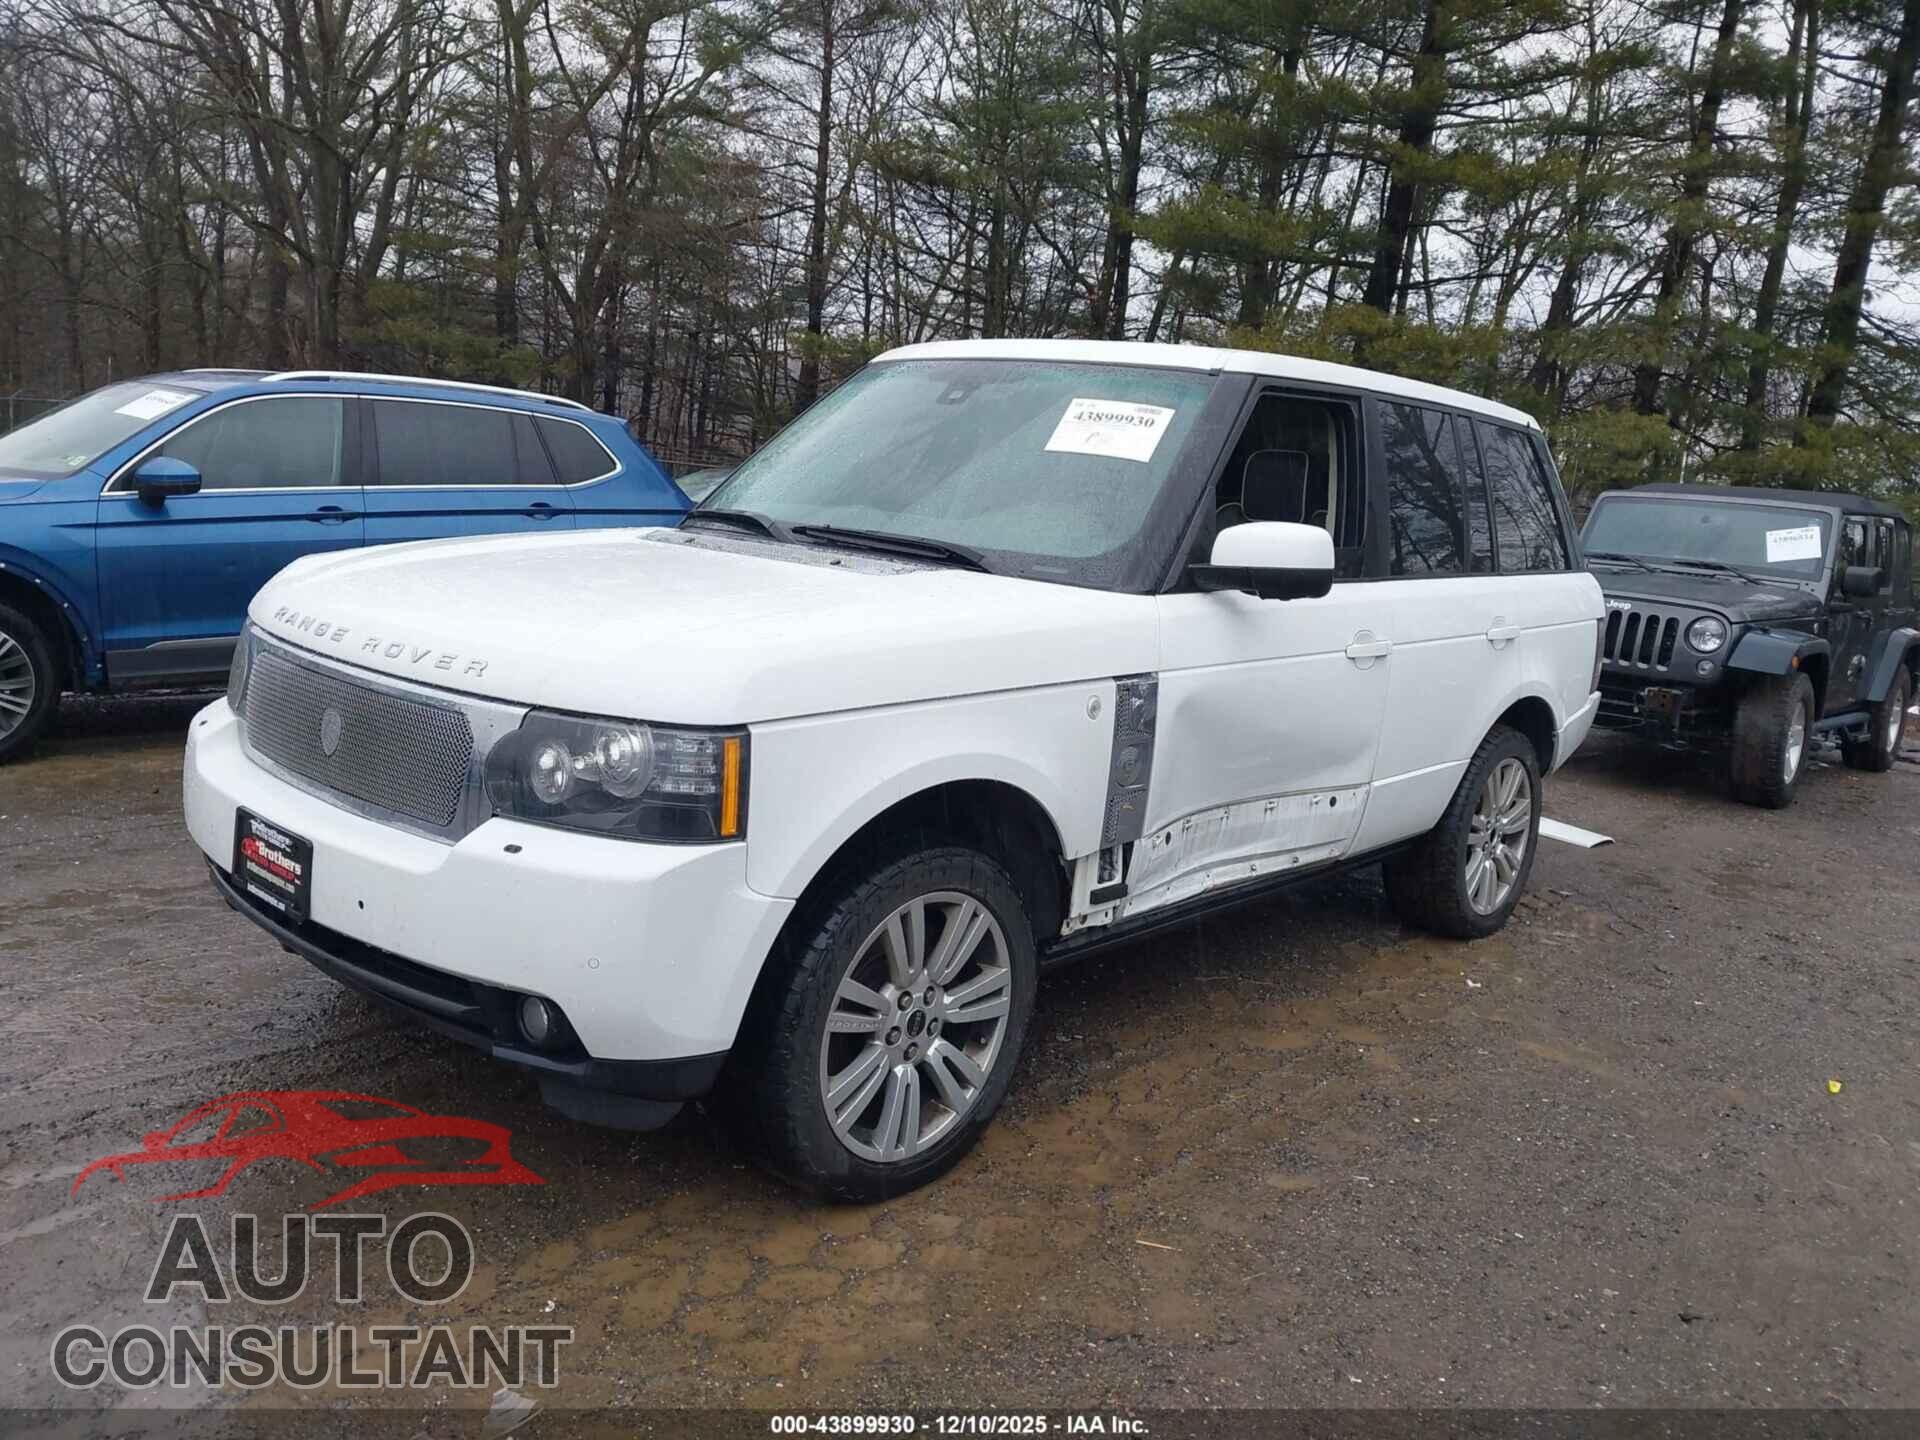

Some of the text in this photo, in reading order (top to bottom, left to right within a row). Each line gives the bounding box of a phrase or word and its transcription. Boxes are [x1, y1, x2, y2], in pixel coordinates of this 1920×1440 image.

[1073, 410, 1155, 428] 43899930
[1606, 600, 1631, 610] Jeep
[274, 606, 488, 677] RANGE ROVER
